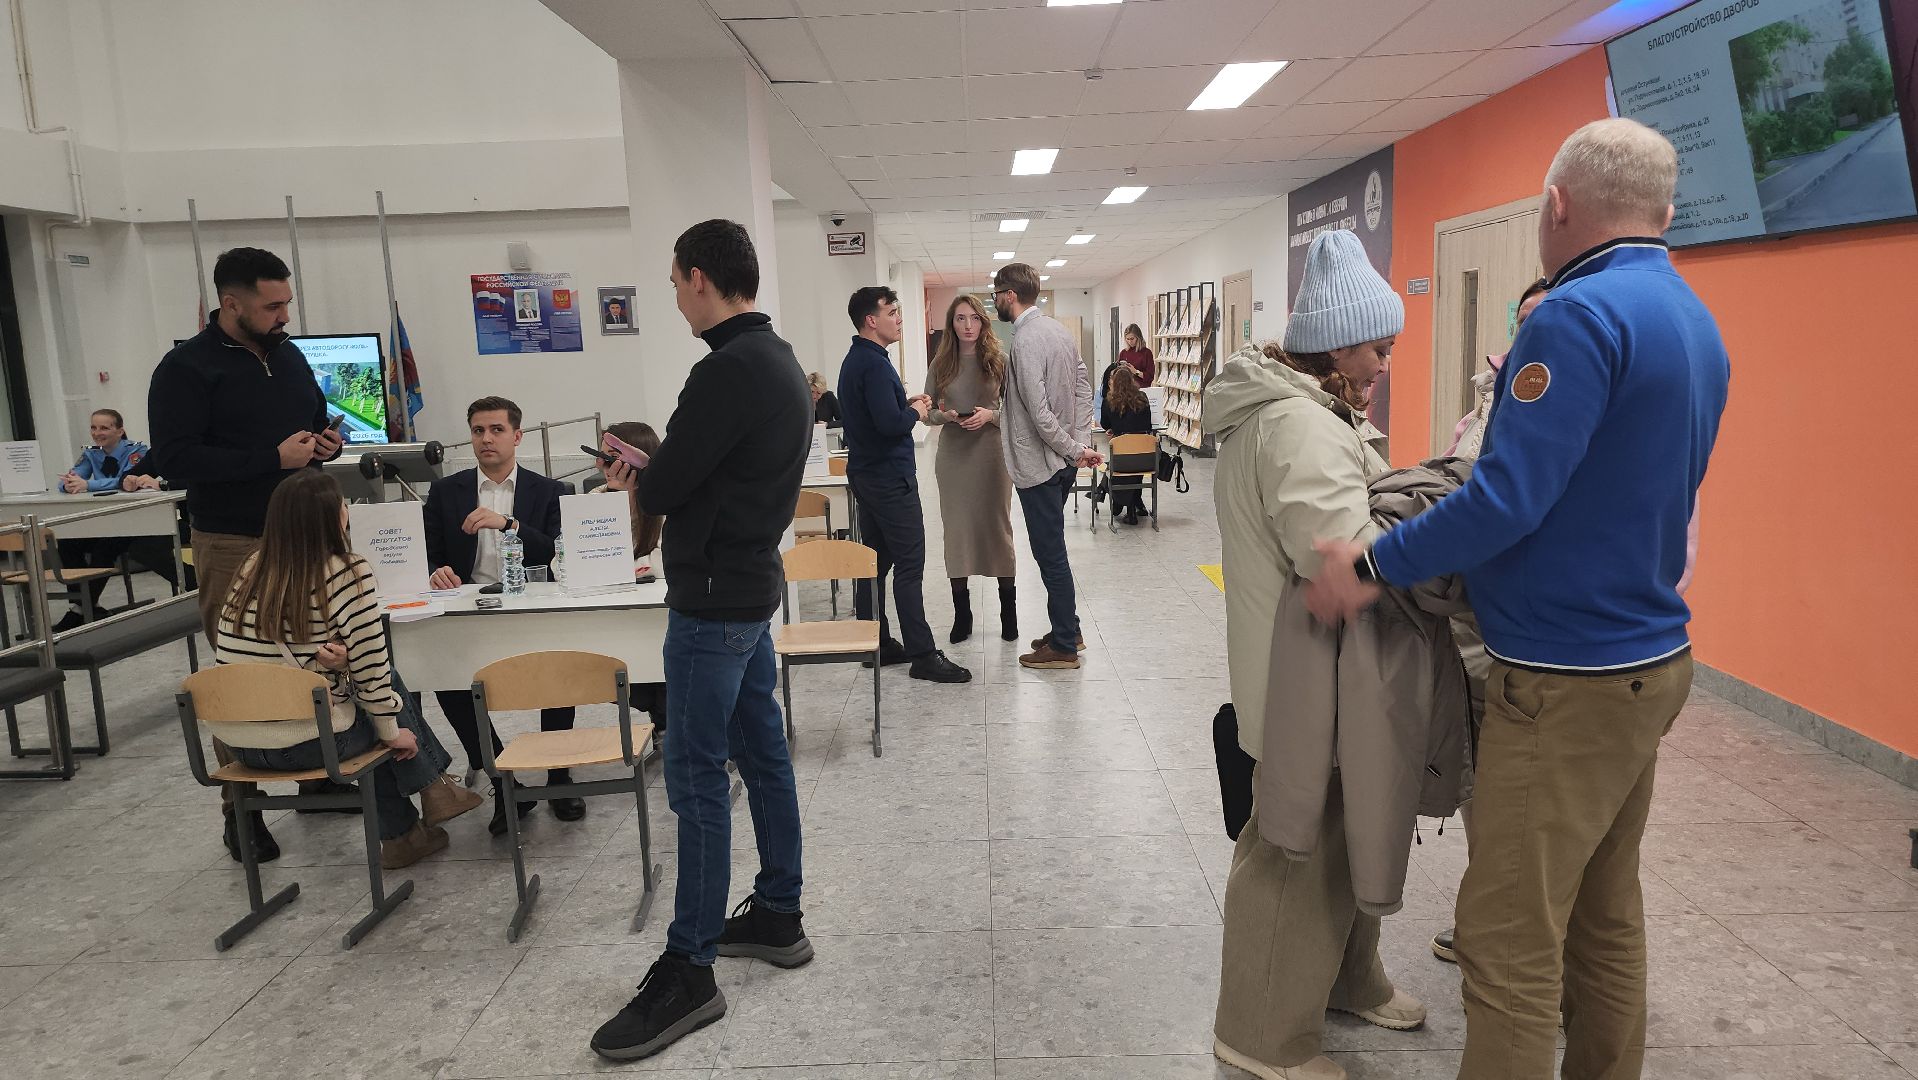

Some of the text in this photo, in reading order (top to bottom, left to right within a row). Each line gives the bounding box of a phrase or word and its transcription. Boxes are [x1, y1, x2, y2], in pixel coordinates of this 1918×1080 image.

[1647, 0, 1760, 50] БЛАГОУСТРОЙСТВО ДВОРОВ
[378, 528, 402, 536] СОВЕТ
[370, 536, 412, 545] ДЕПУТАТОВ
